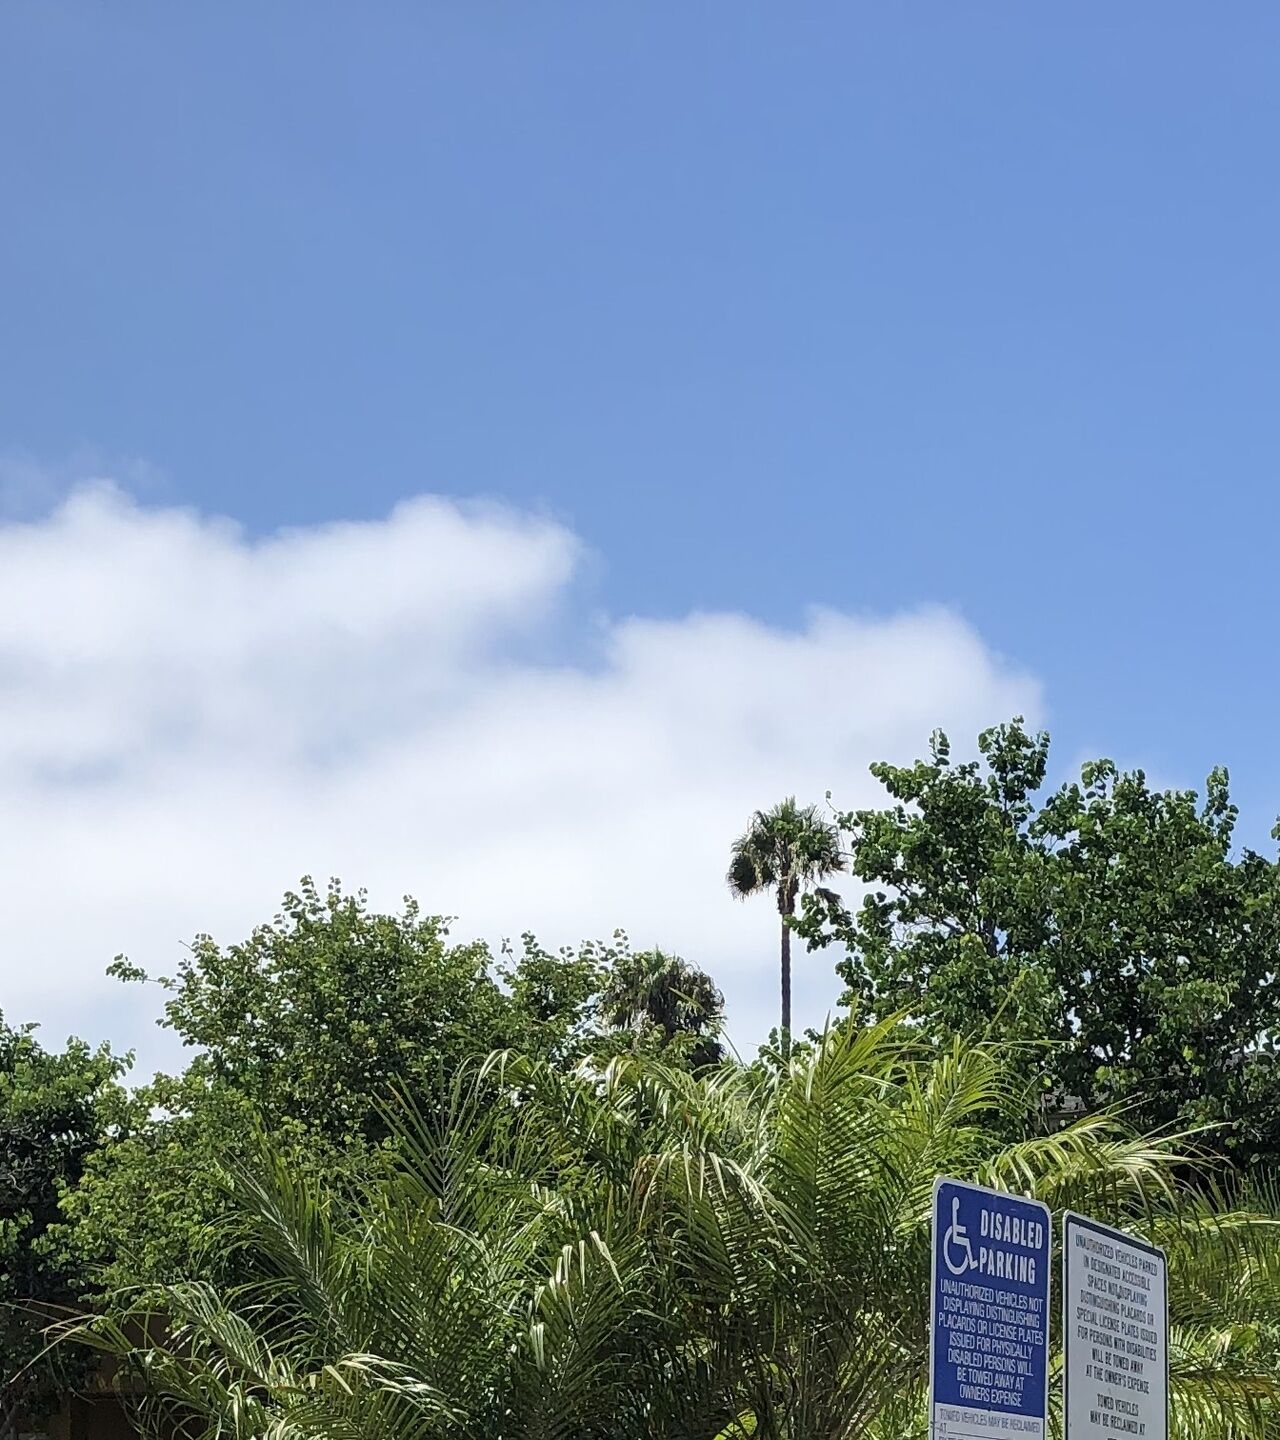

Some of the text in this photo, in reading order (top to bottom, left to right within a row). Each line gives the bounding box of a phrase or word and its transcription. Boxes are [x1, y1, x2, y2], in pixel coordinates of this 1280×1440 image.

[980, 1209, 1042, 1249] DISABLED
[980, 1246, 1036, 1284] PARKING
[940, 1278, 1044, 1312] UNAUTHORIZED VEHICLES NOT
[943, 1296, 1040, 1328] DISPLAYING DISTINGUISHING
[938, 1312, 1044, 1345] PLACARDS OR LICENSE PLATES
[1078, 1325, 1088, 1340] FOR
[949, 1330, 1033, 1360] ISSUED FOR PHYSICALLY
[948, 1348, 1034, 1376] DISABLED PERSONS WILL
[957, 1366, 1024, 1390] BE TOWED AWAY AT
[991, 1388, 1022, 1407] EXPENSE
[939, 1422, 948, 1433] AT
[1001, 1418, 1009, 1429] BE
